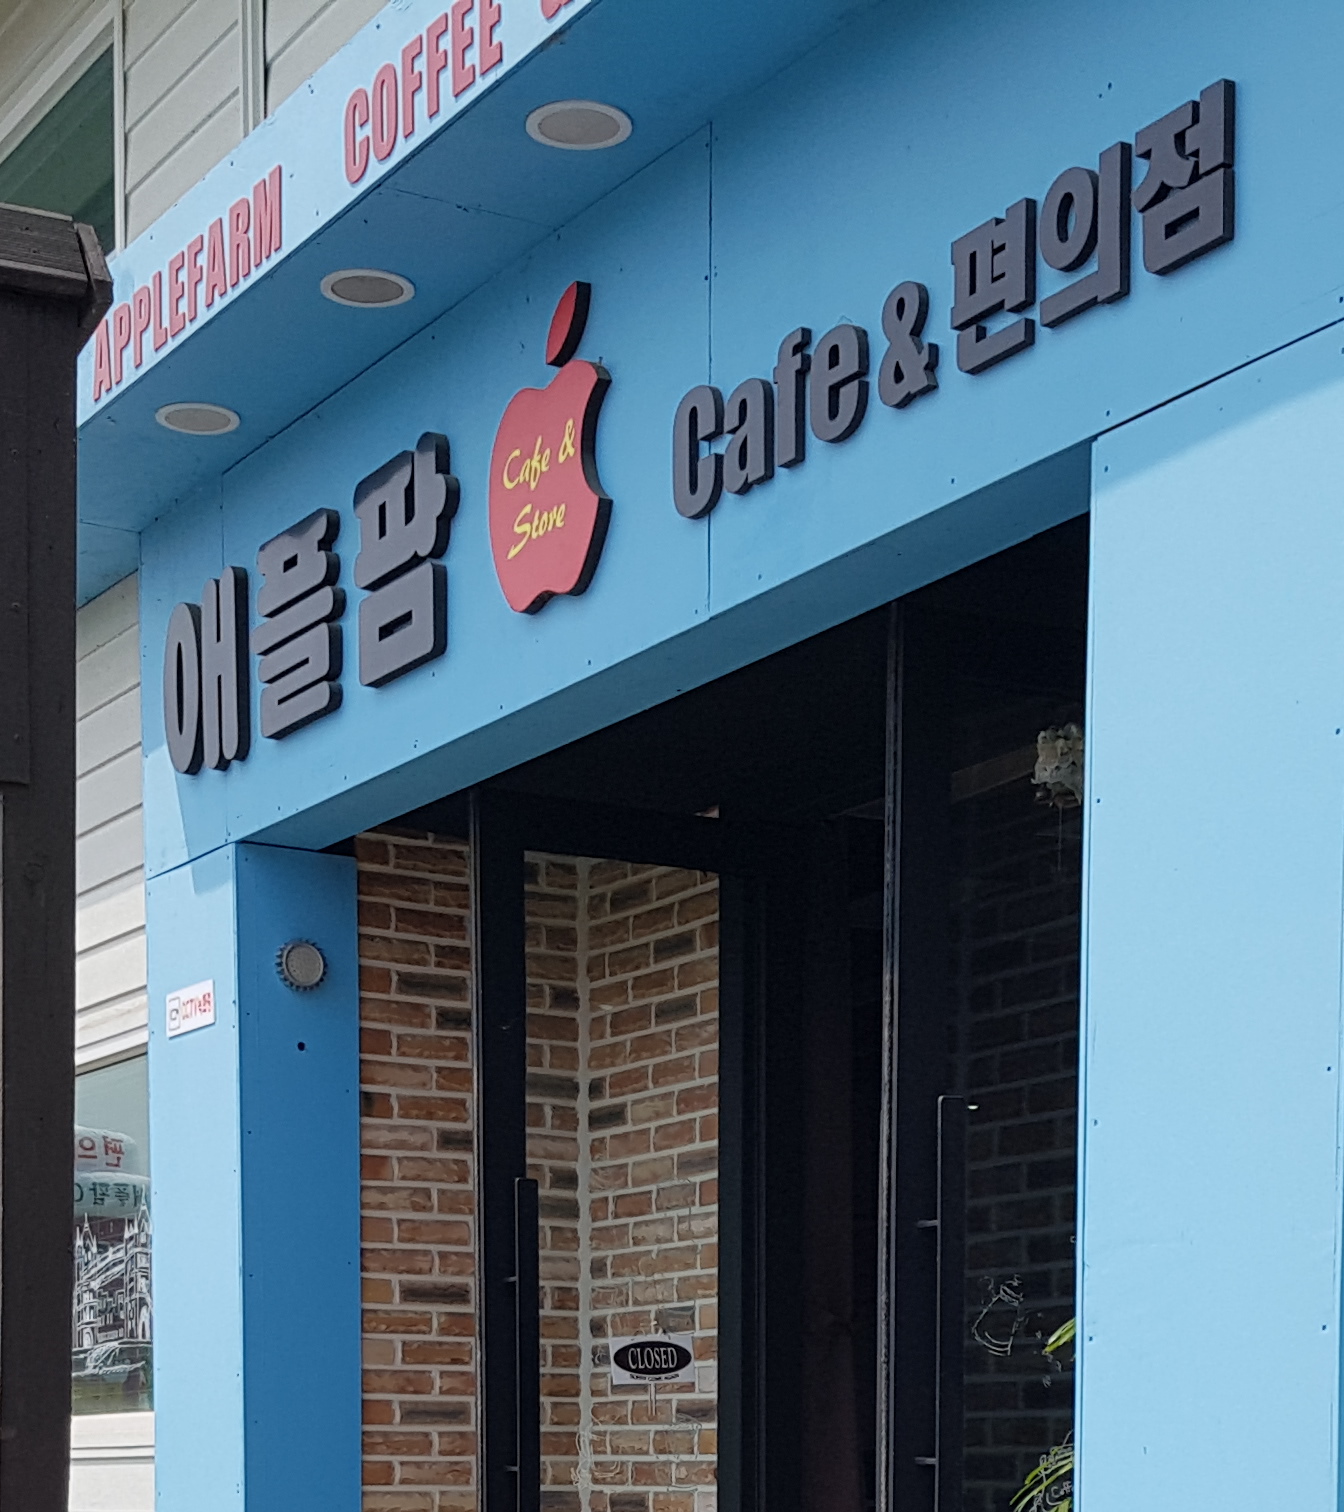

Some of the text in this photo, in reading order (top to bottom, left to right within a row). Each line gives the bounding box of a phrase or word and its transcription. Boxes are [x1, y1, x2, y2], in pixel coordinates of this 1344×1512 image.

[93, 0, 503, 402] APPLEFARM COFFEE
[503, 418, 575, 491] Cafe &
[507, 503, 566, 560] Store
[163, 432, 460, 775] 애플팜
[628, 1347, 678, 1370] CLOSED
